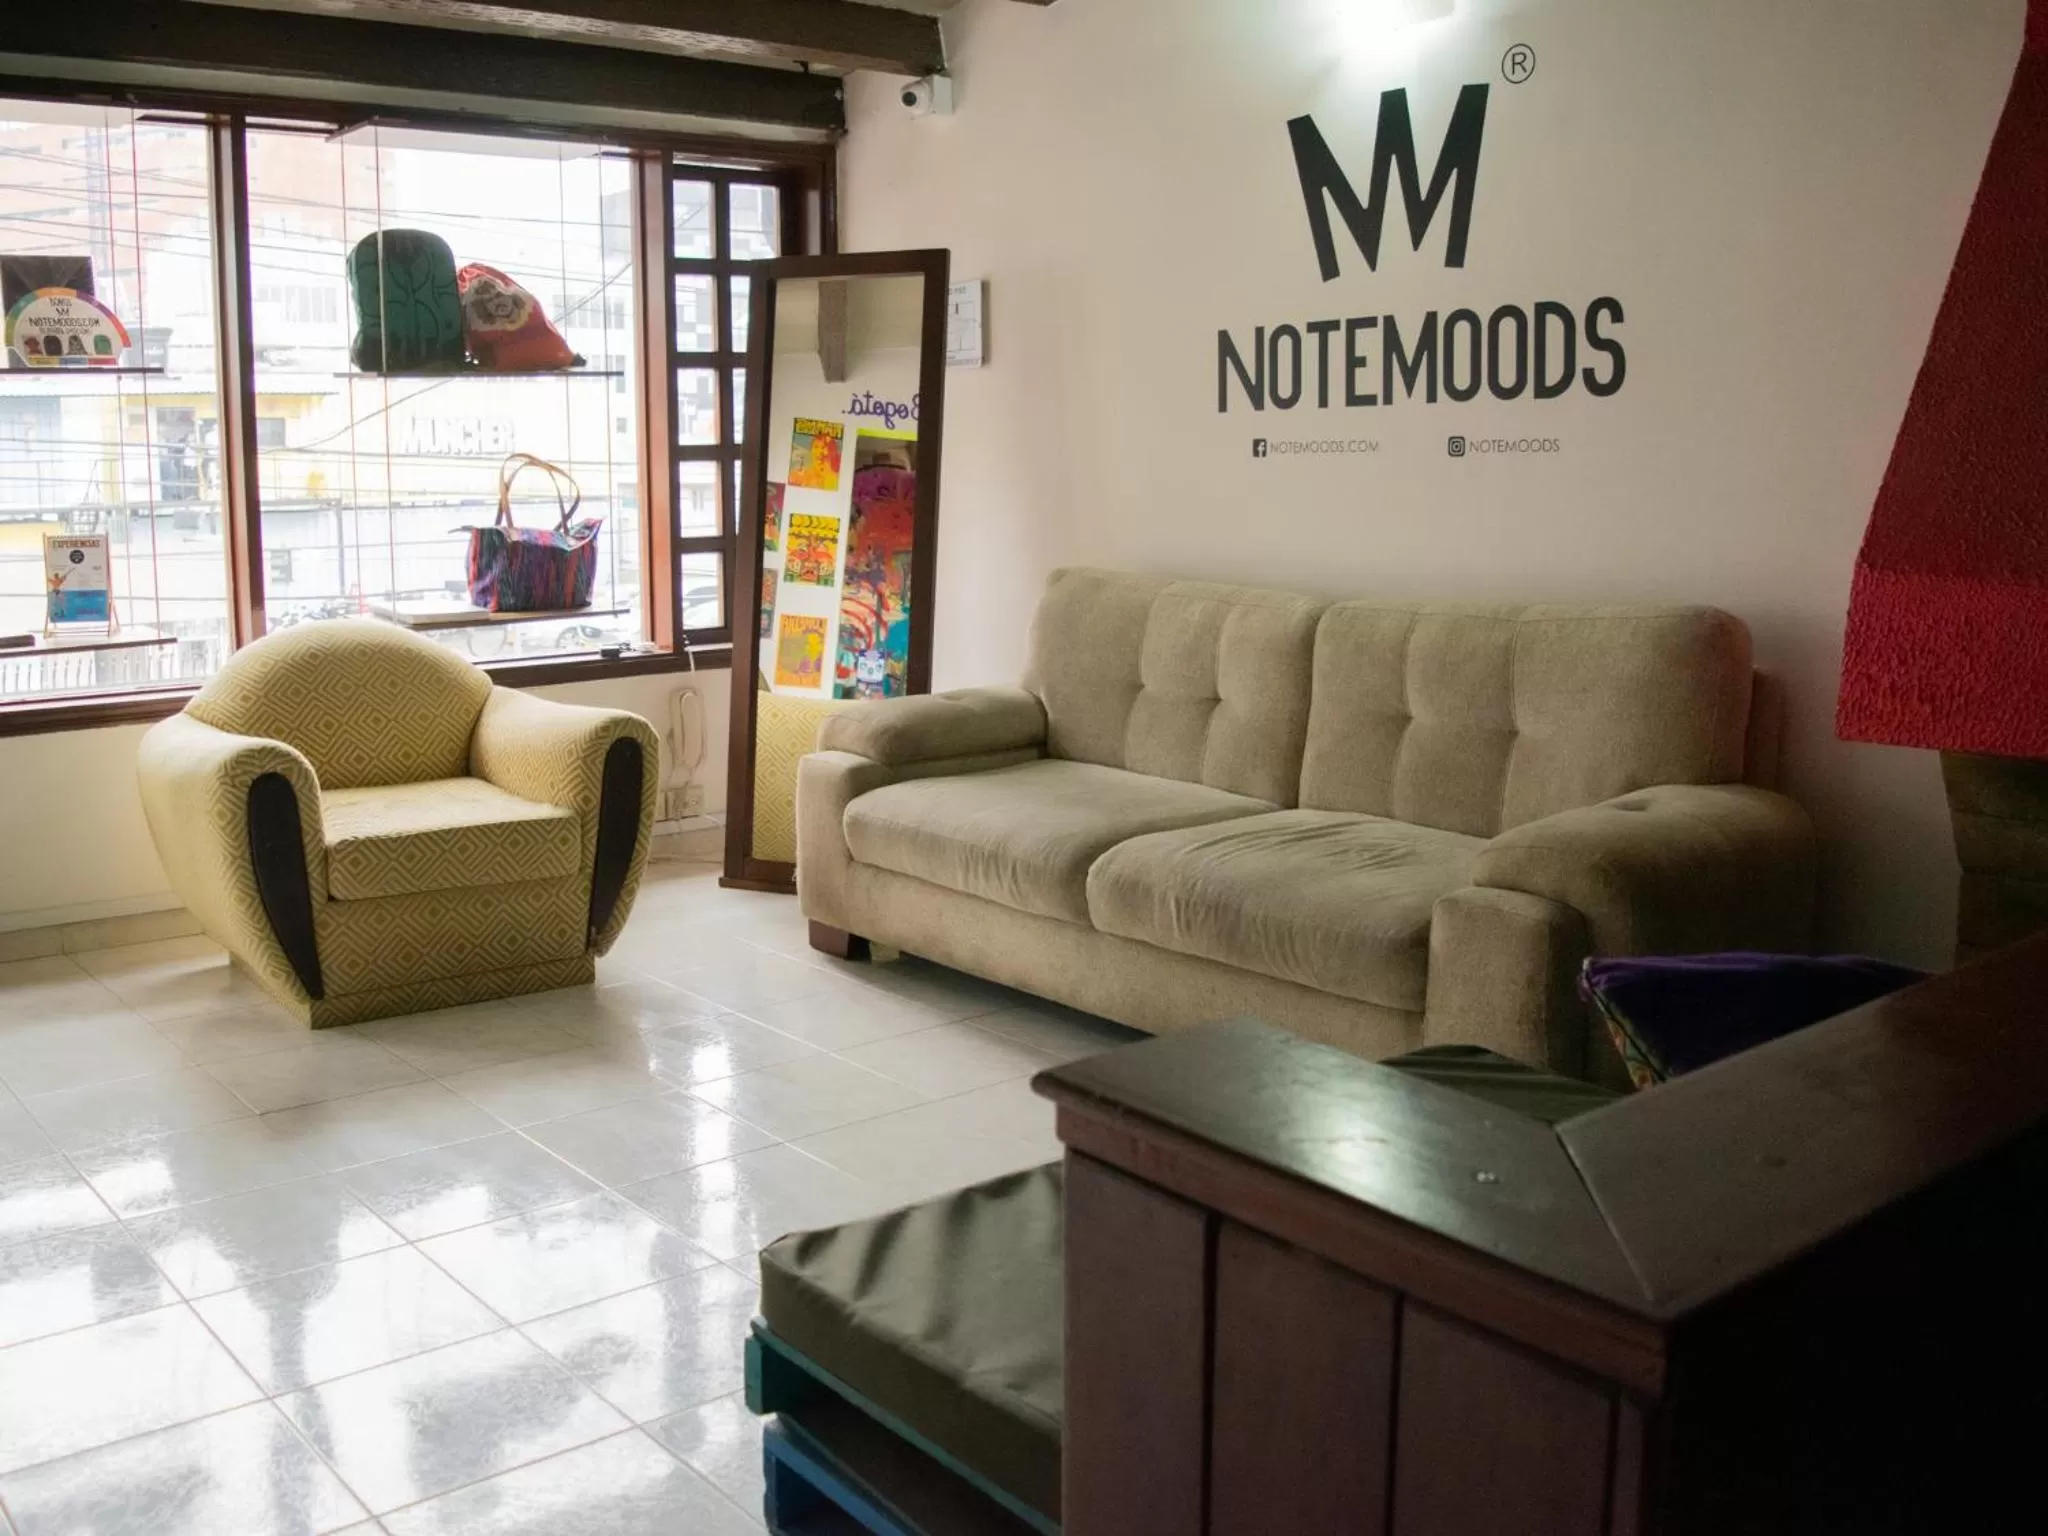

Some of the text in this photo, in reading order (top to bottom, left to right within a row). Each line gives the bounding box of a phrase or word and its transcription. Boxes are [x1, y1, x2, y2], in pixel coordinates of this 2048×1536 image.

[1217, 296, 1627, 413] NOTEMOODS
[1269, 438, 1379, 454] NOTEMOODS.COM
[1468, 437, 1561, 453] NOTEMOODS
